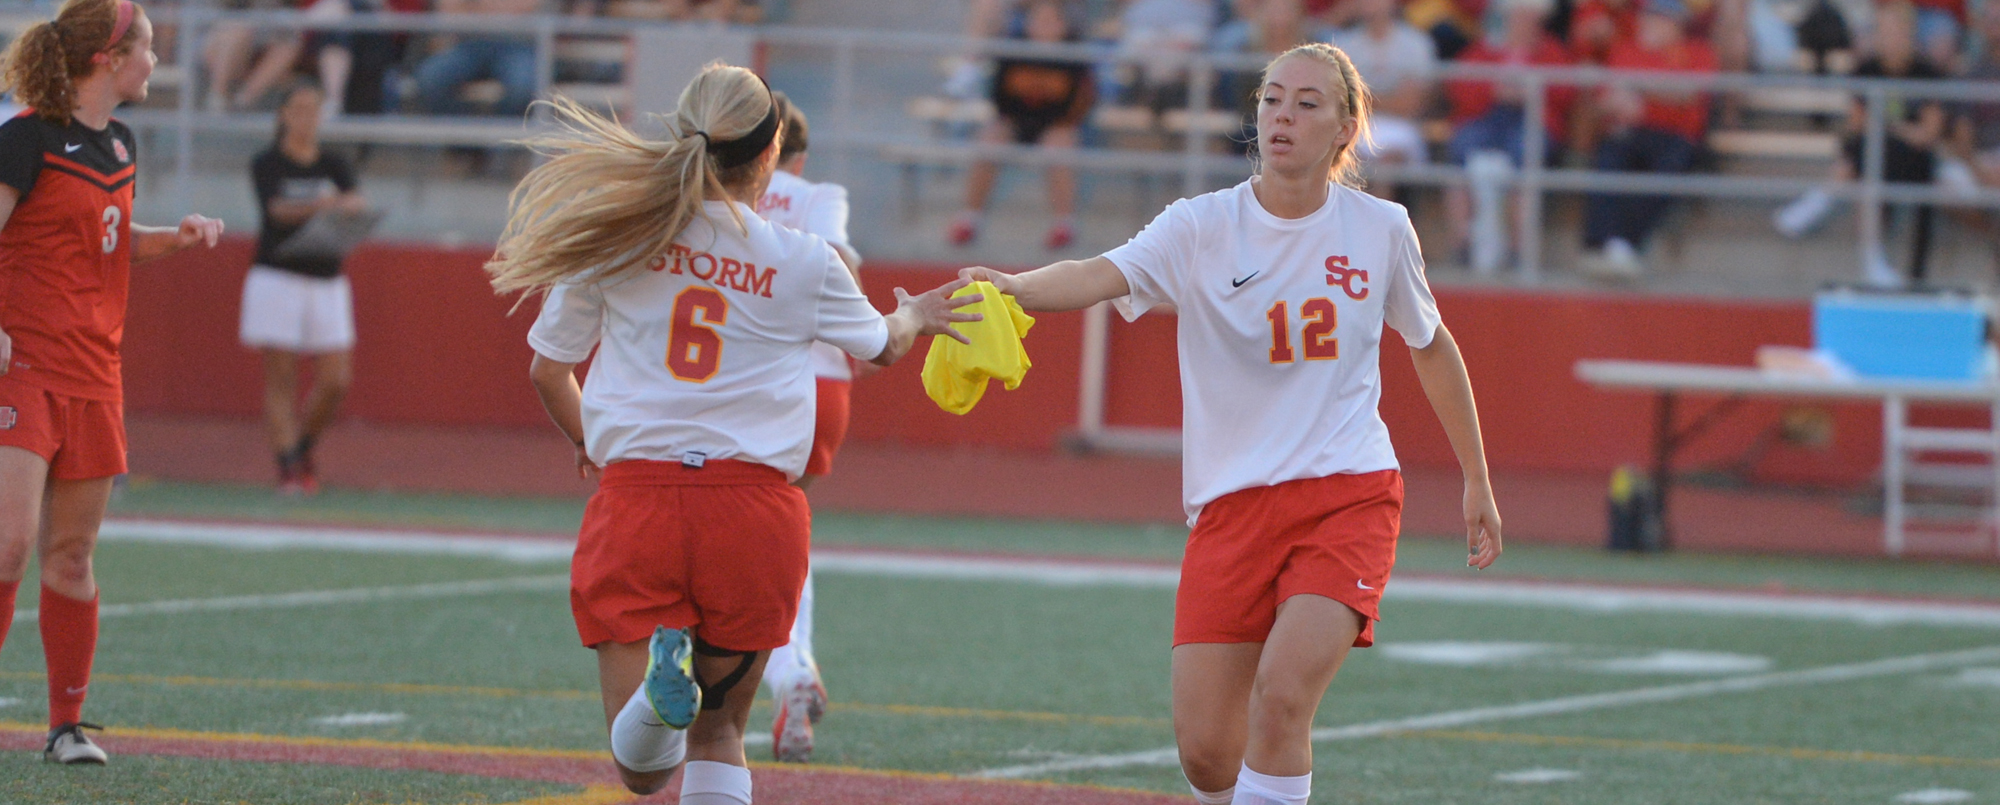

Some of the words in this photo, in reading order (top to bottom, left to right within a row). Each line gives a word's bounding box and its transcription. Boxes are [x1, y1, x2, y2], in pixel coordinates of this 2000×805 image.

[103, 206, 120, 253] 3
[1325, 256, 1368, 300] SC
[665, 285, 729, 383] 6
[1267, 297, 1338, 363] 12
